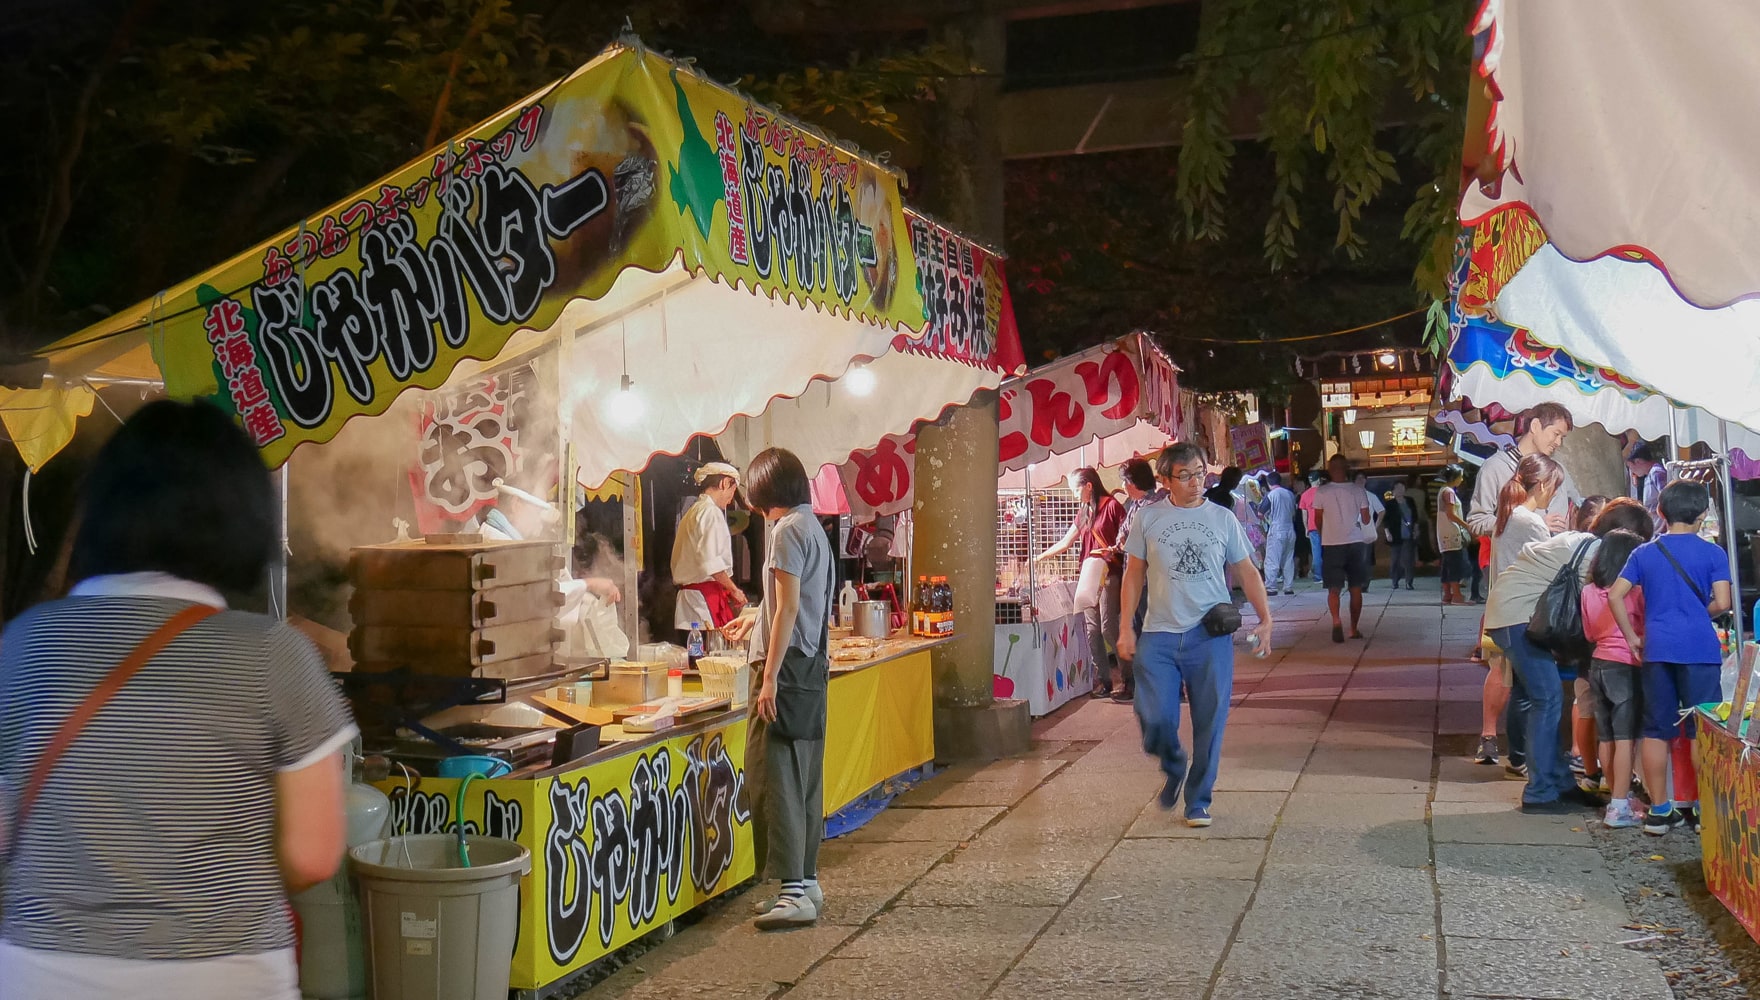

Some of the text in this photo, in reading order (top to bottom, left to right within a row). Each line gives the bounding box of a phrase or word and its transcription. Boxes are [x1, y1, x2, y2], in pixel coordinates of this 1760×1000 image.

[714, 111, 749, 267] 北海道産
[740, 123, 877, 305] じゃがバター
[205, 299, 286, 447] 北海道産
[252, 165, 608, 428] じゃがバター
